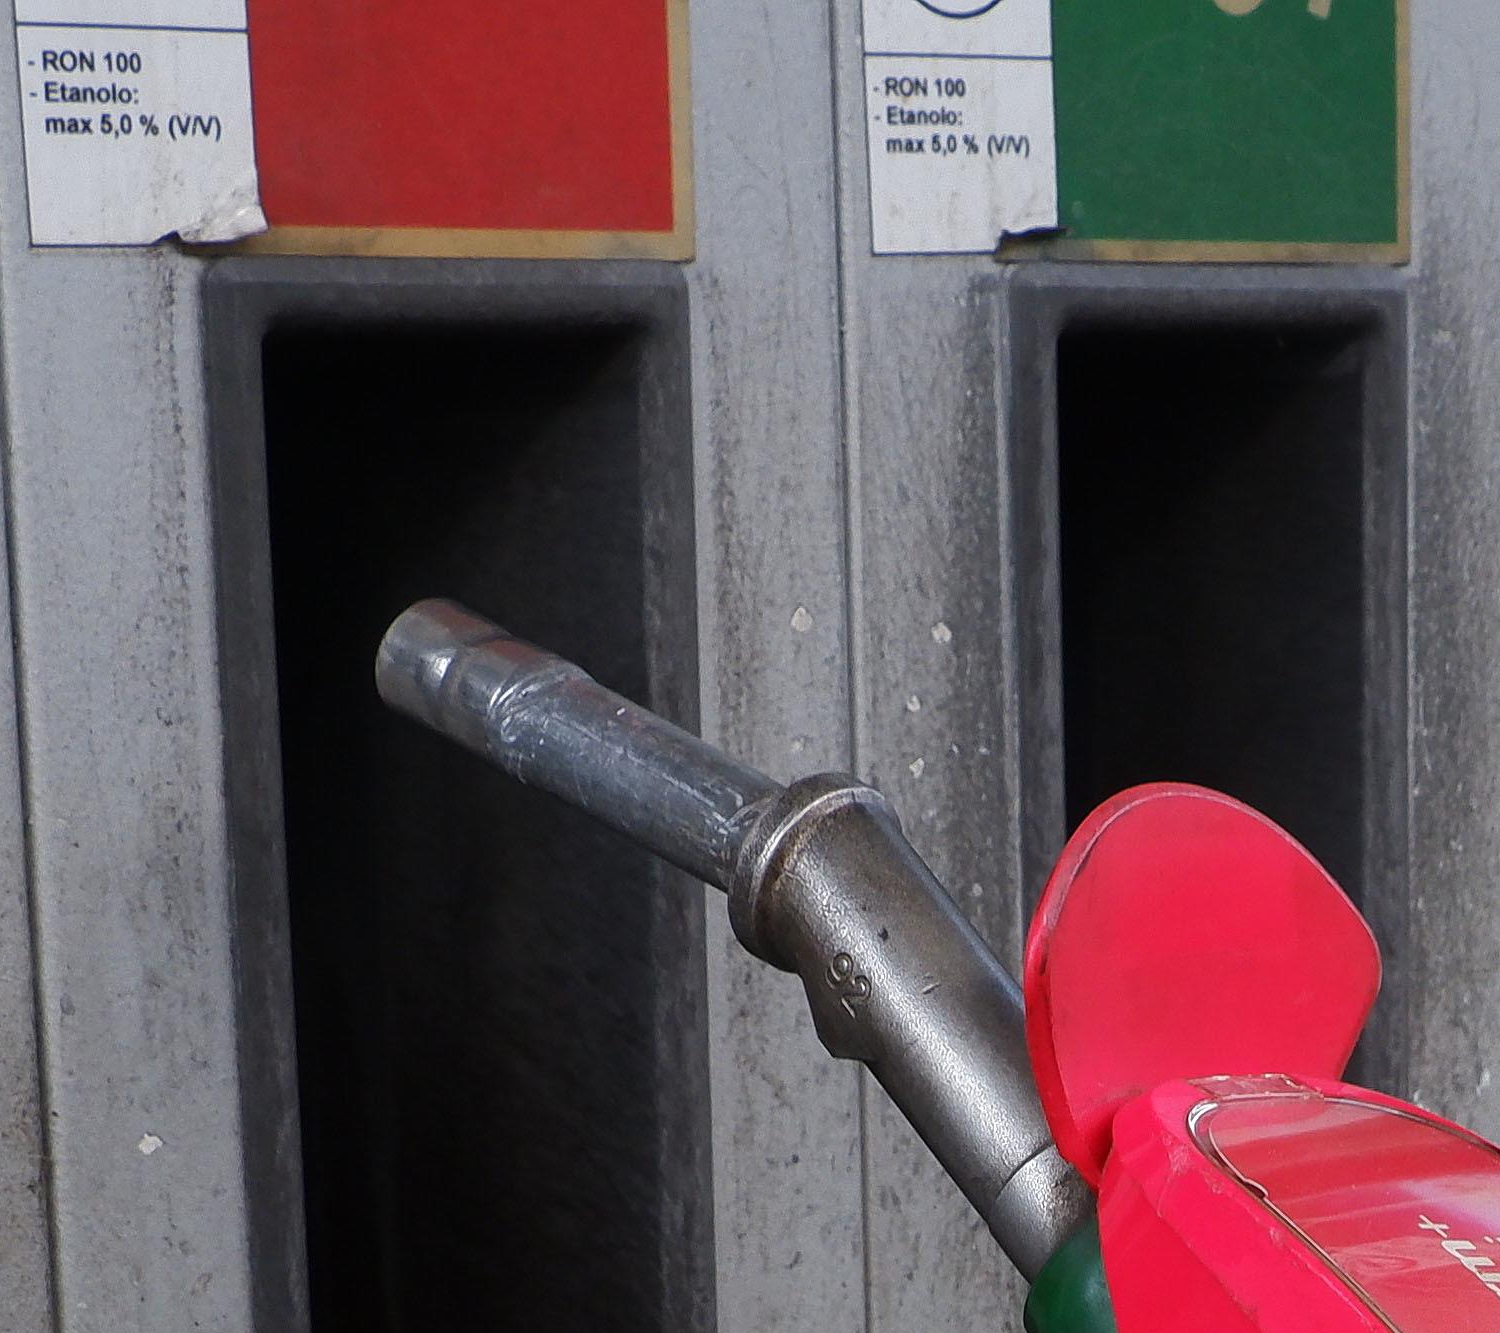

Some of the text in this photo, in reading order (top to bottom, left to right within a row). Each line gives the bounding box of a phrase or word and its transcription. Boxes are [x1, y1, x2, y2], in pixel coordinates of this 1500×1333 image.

[41, 50, 142, 74] RON 100
[44, 81, 140, 104] Etanolo:
[885, 77, 966, 98] RON 100
[45, 114, 222, 142] max 5,0 % (V/V)
[886, 106, 963, 127] Etanolo:
[886, 137, 925, 154] max
[931, 134, 957, 157] 5,0
[962, 136, 979, 156] %
[825, 951, 872, 1019] 92
